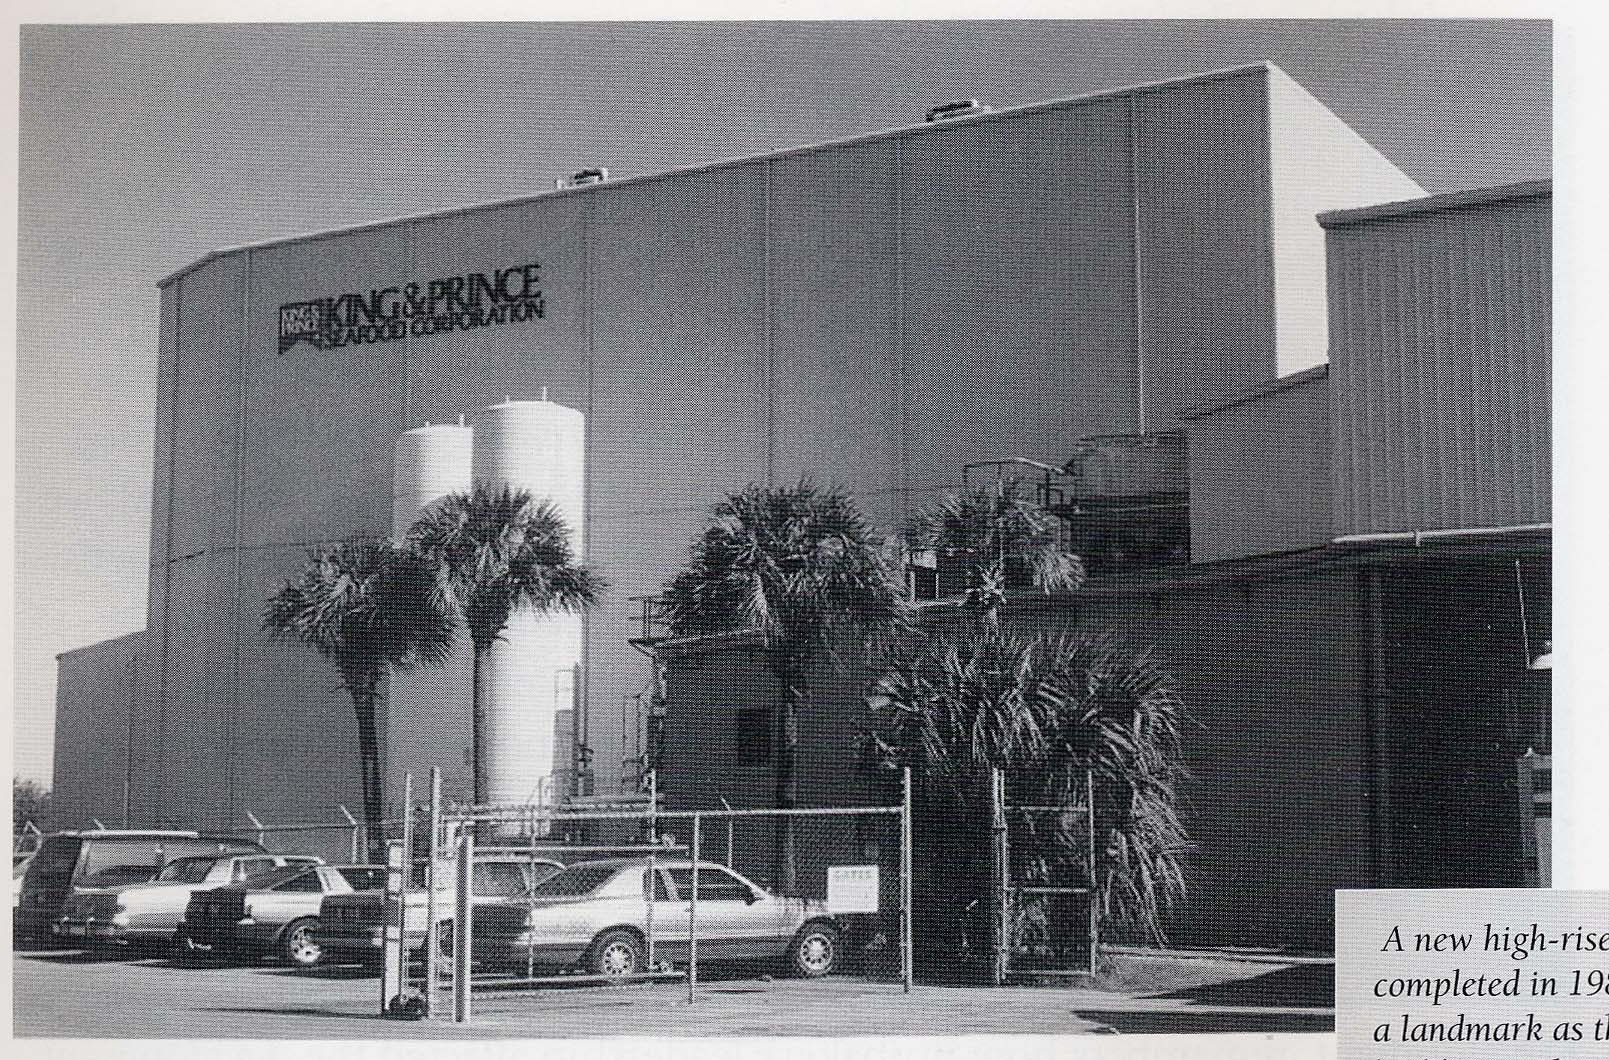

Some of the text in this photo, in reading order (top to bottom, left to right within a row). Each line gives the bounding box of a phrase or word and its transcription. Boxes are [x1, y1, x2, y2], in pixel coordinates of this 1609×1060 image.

[322, 299, 545, 349] SEAFOOD CORPORATION
[325, 263, 542, 328] KING & PRINCE
